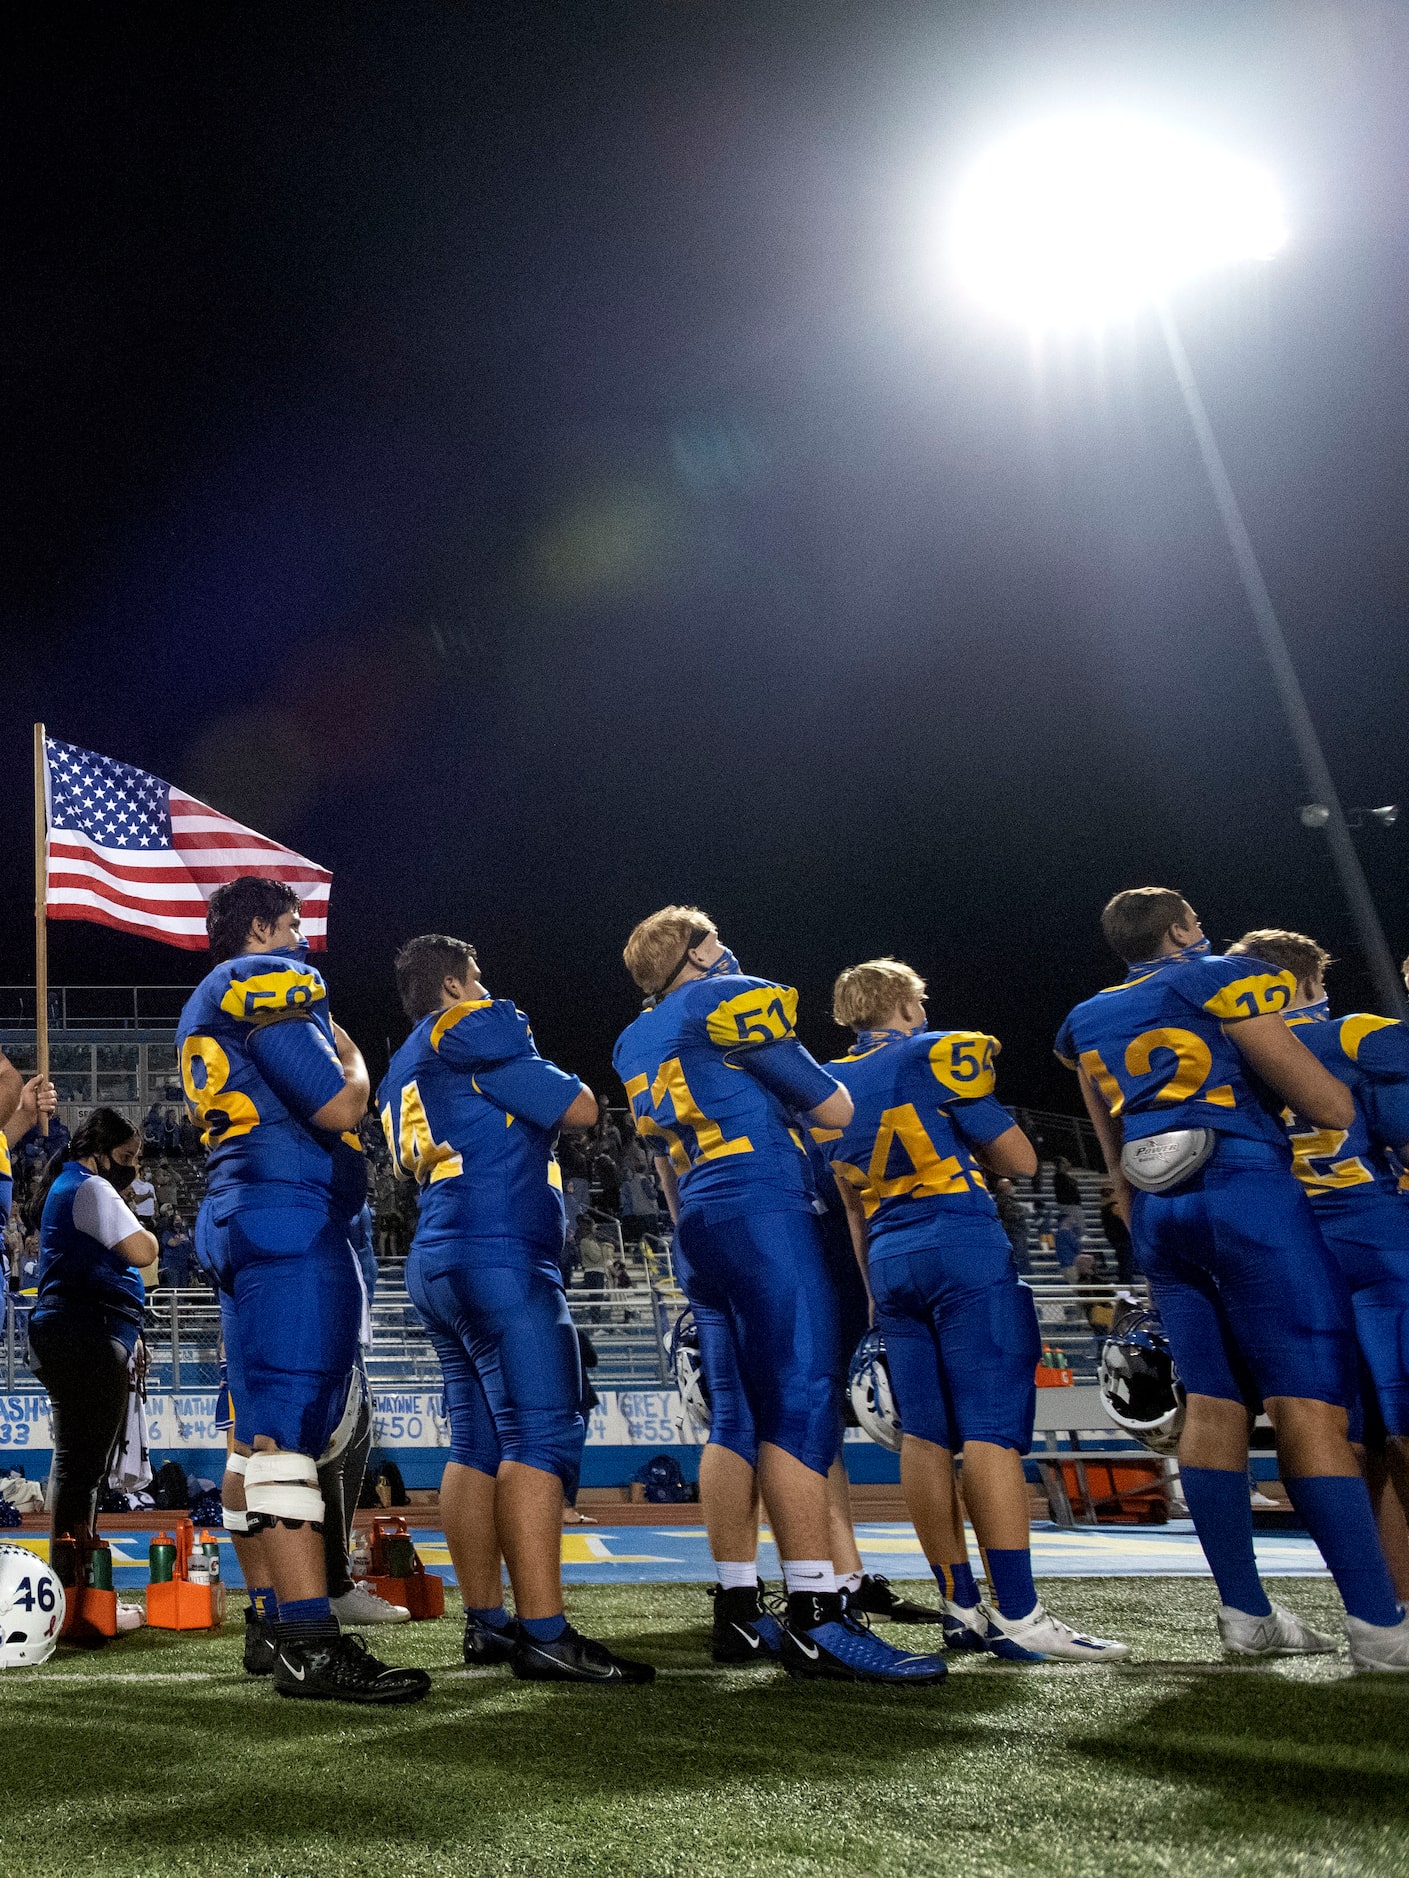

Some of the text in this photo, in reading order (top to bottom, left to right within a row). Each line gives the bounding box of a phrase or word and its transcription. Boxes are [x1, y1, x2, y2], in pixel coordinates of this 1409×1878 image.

[733, 997, 793, 1042] 51
[620, 1392, 671, 1418] GREY
[372, 1416, 423, 1440] #50
[632, 1418, 675, 1443] #55
[13, 1576, 56, 1612] 46
